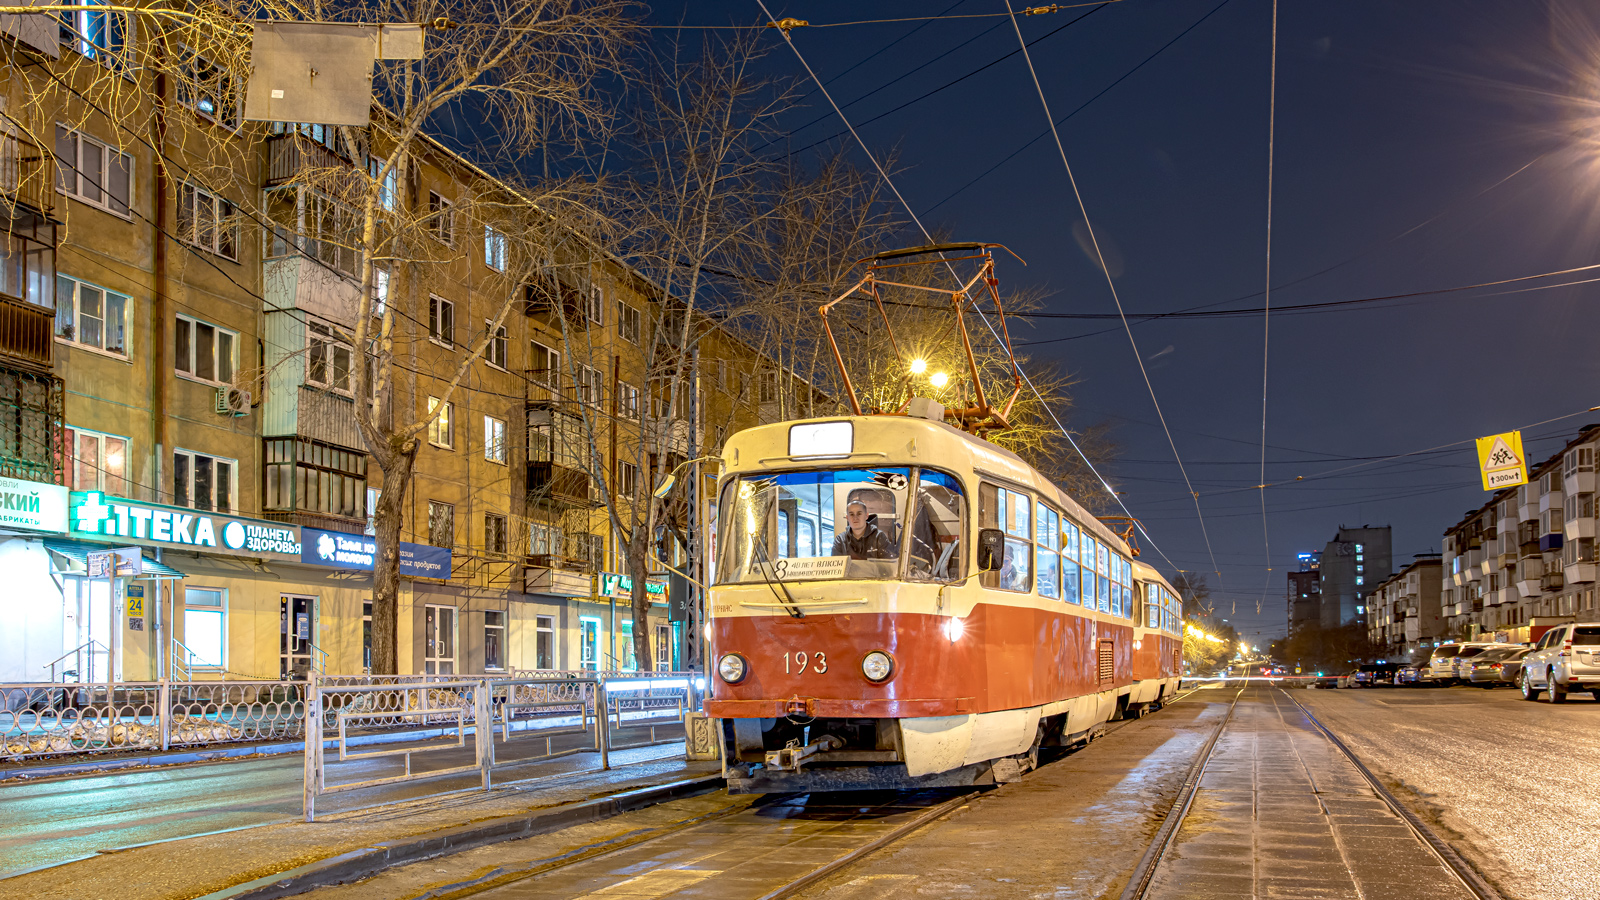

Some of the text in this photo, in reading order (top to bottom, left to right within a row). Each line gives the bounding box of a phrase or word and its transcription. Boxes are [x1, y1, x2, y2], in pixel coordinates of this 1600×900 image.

[1496, 474, 1515, 483] 300м
[246, 525, 295, 543] ПЛАНЕТА
[246, 537, 302, 554] ЗДОРОВЬЯ
[775, 560, 788, 579] 8
[129, 599, 142, 611] 24
[784, 651, 828, 675] 193
